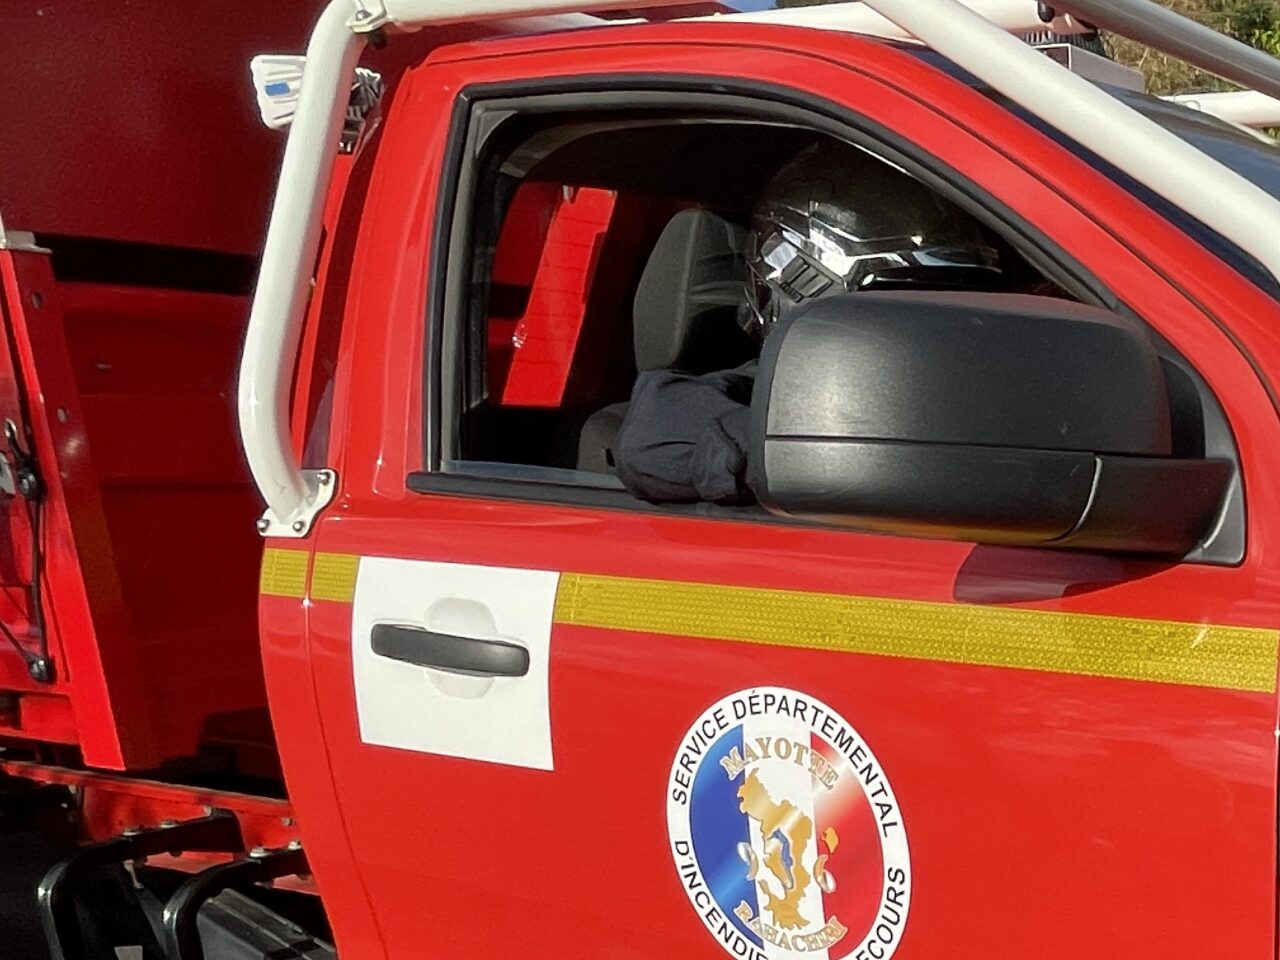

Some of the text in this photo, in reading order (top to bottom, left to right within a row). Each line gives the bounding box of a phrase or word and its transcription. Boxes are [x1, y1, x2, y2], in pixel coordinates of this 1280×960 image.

[673, 690, 898, 838] SERVICE DÉPARTEMENTAL
[720, 737, 840, 790] MAYOTTE
